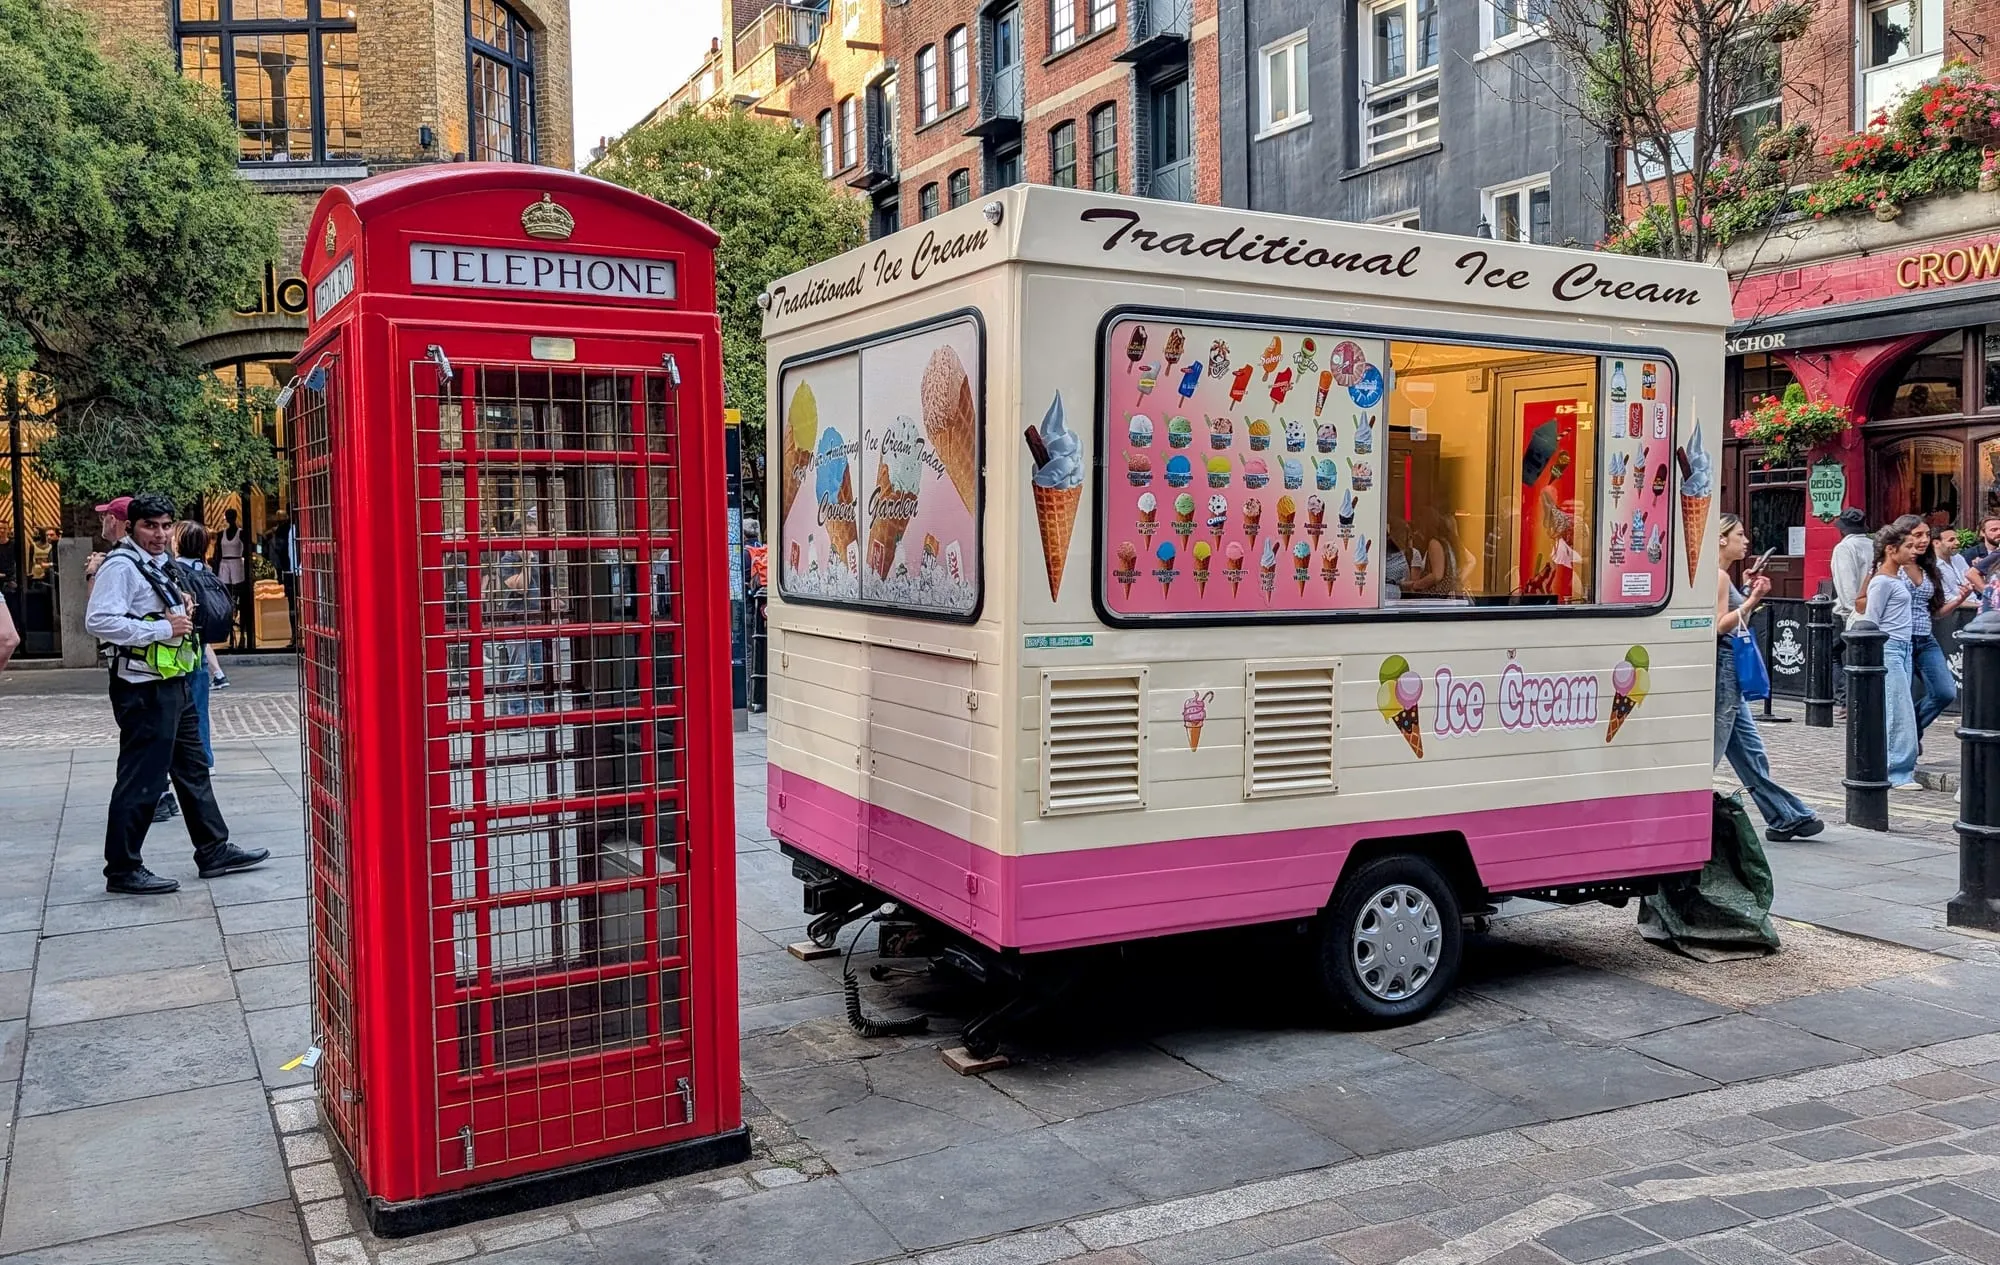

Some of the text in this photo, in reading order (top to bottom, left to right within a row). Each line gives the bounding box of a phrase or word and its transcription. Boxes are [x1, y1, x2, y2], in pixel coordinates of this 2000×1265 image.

[420, 249, 667, 295] TELEPHONE
[773, 228, 989, 319] Traditional Ice Cream
[1080, 208, 1702, 305] Traditional Ice Cream
[824, 436, 860, 462] Amazing
[864, 428, 878, 450] Ice
[882, 429, 912, 456] Cream
[915, 437, 946, 481] Today
[818, 487, 919, 529] Covent Garden
[1812, 492, 1841, 502] STOUT
[1773, 664, 1801, 675] ANCHOR
[1434, 663, 1598, 735] Ice Cream
